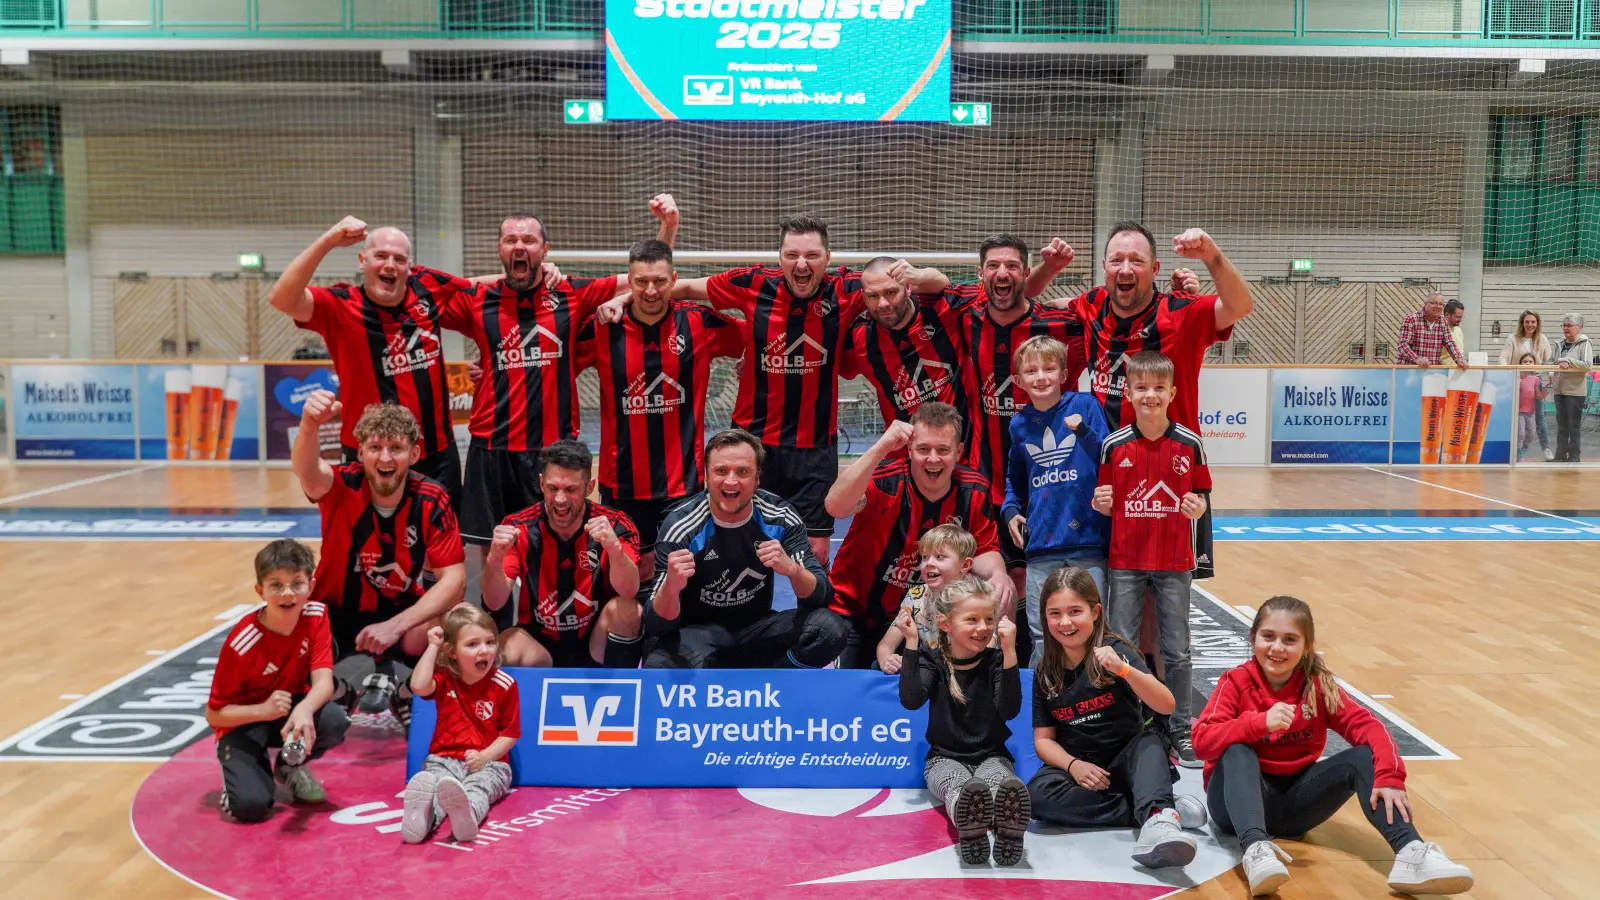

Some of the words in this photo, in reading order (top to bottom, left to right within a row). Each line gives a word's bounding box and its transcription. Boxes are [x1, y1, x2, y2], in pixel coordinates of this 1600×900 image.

[716, 22, 841, 49] 2025
[739, 77, 761, 90] VR
[764, 77, 802, 90] Bank
[740, 92, 842, 106] Bayreuth-Hof
[844, 92, 866, 104] eG
[381, 348, 427, 371] KOLB
[496, 346, 542, 364] KOLB
[760, 353, 805, 368] KOLB
[384, 359, 435, 377] Bedachungen
[498, 359, 551, 371] Bedachungen
[761, 364, 814, 375] Bedachungen
[25, 382, 79, 404] Maisel's
[84, 382, 132, 404] Weisse
[893, 378, 935, 407] KOLB
[897, 385, 945, 411] Bedachungen
[1284, 385, 1337, 408] Maisel's
[1341, 386, 1388, 407] Weisse
[622, 394, 665, 409] KOLB
[1453, 393, 1467, 418] Weisse
[27, 411, 132, 424] ALKOHOLFREI
[623, 406, 673, 416] Bedachungen
[1226, 411, 1247, 425] eG
[1284, 415, 1387, 426] ALKOHOLFREI
[1201, 430, 1247, 440] scheidung.
[1032, 469, 1078, 488] adidas
[1125, 500, 1162, 512] KOLB
[1125, 511, 1168, 519] Bedachungen
[882, 574, 915, 589] Bedach
[700, 587, 748, 602] KOLB
[700, 594, 755, 608] Bedachungen
[656, 684, 697, 708] VR
[705, 683, 781, 708] Bank
[655, 717, 862, 748] Bayreuth-Hof
[871, 719, 912, 742] eG
[703, 753, 731, 766] Die
[734, 752, 796, 769] richtige
[799, 752, 911, 769] Entscheidung.
